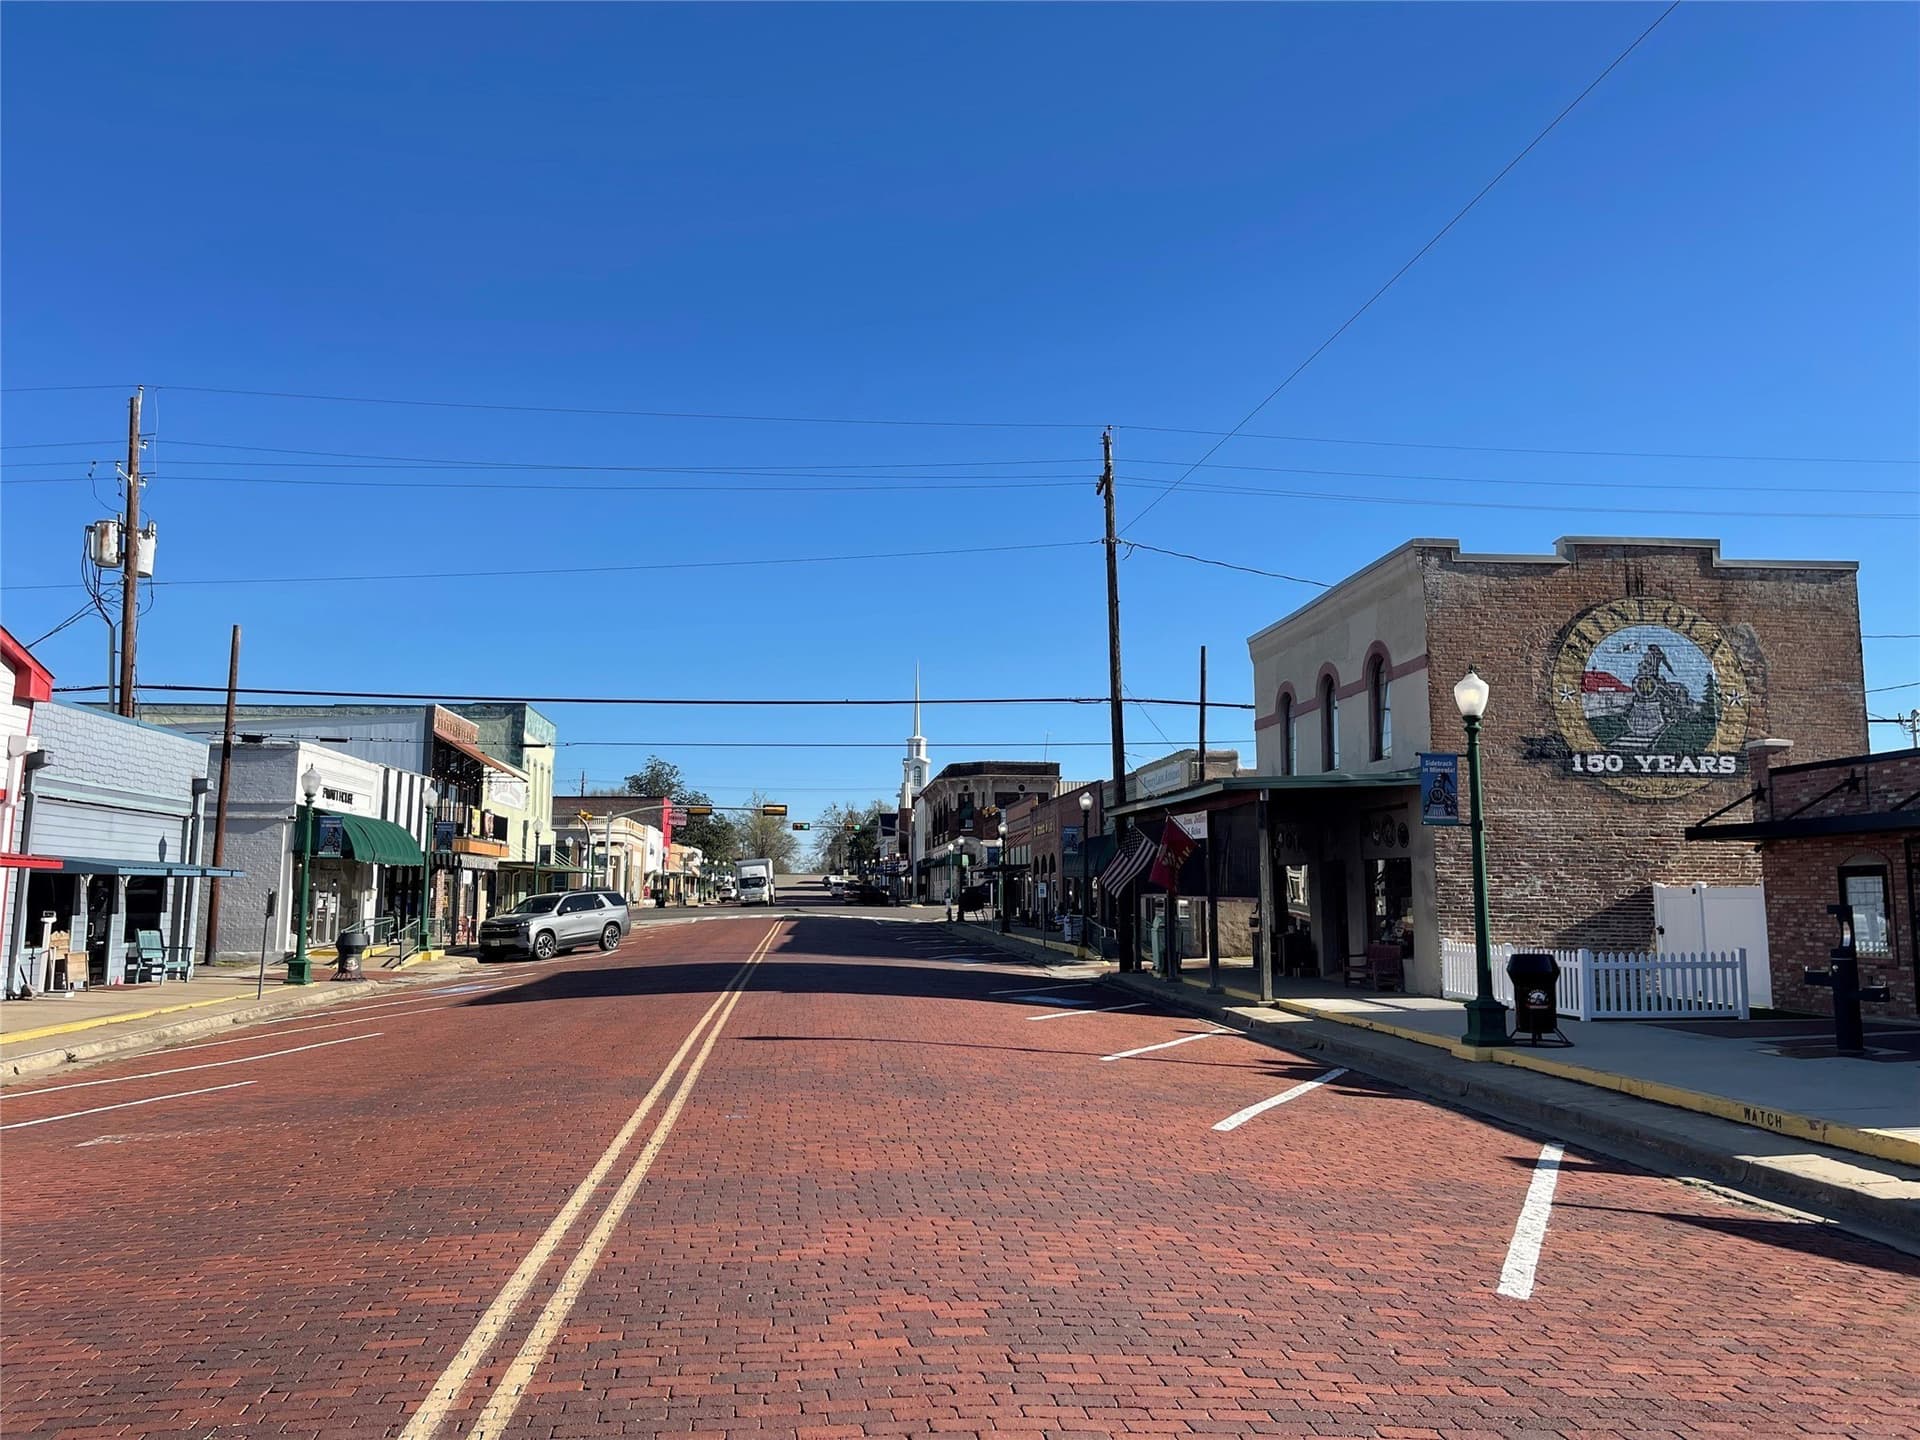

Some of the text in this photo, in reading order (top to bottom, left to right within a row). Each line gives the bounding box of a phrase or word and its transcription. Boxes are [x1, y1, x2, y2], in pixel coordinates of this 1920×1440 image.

[1566, 598, 1722, 660] MINEOLA
[1425, 759, 1453, 767] Sidetrack
[1571, 754, 1737, 774] 150 YEARS
[1743, 1107, 1782, 1128] WATCH
